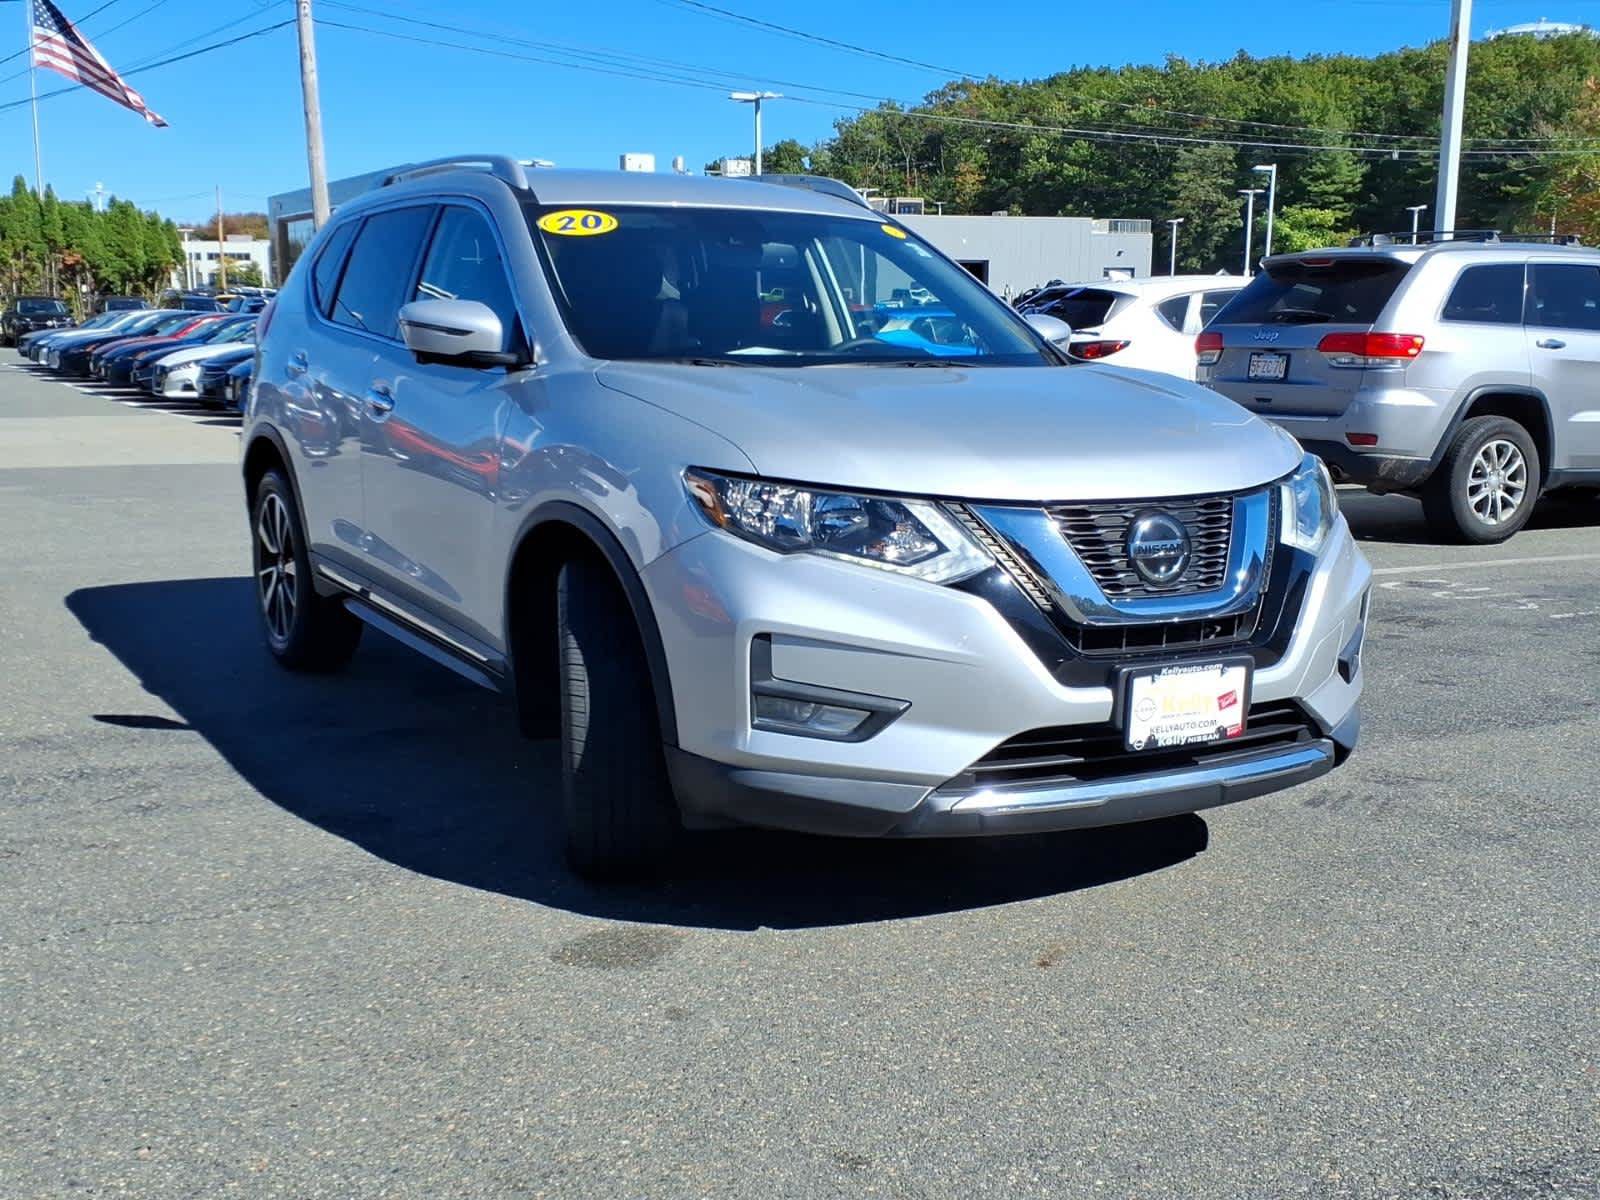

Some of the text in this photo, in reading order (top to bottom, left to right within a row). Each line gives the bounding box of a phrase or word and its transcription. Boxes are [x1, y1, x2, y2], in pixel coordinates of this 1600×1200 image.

[556, 214, 602, 231] 20
[1254, 328, 1279, 342] Jeep
[1137, 543, 1184, 555] NISSAN
[1149, 719, 1217, 735] KELLYAUTO.COM
[1157, 733, 1220, 746] Kelly NISSAN
